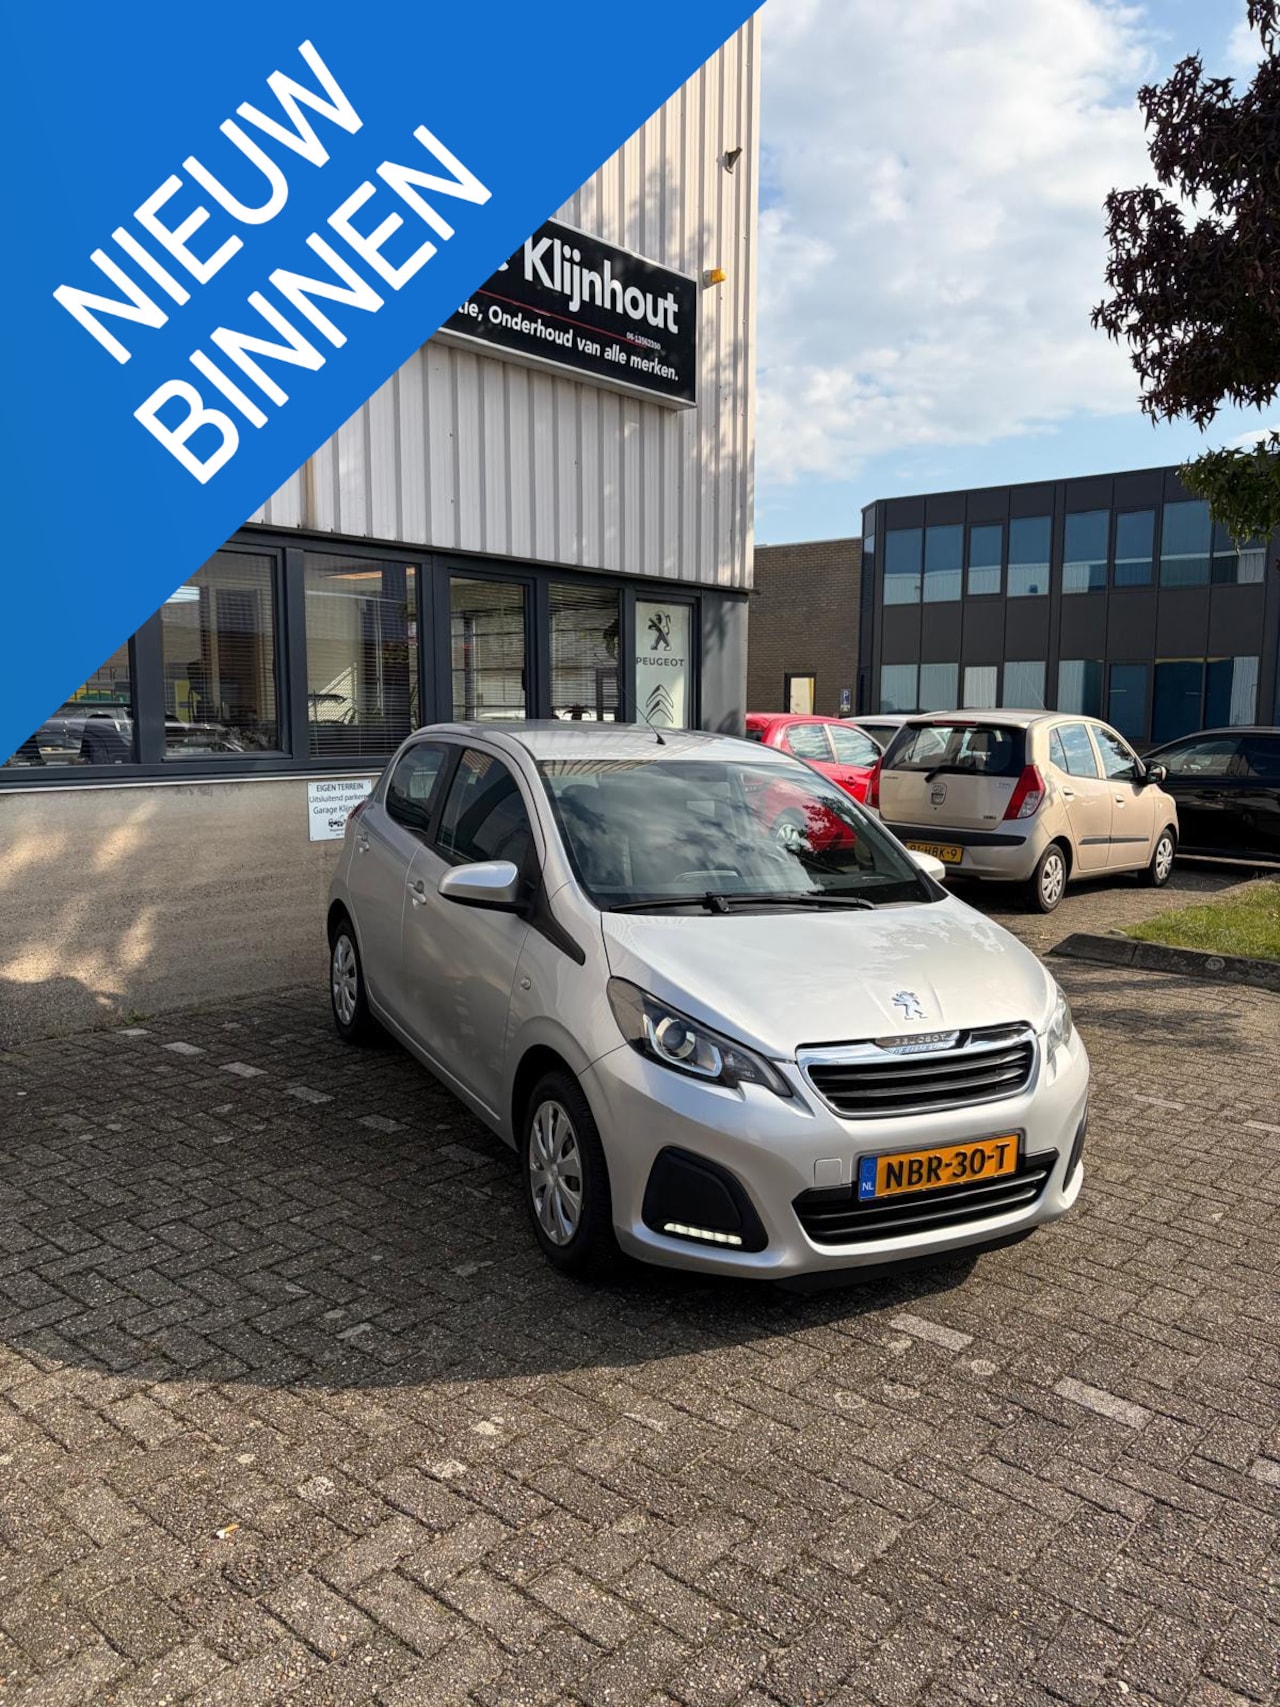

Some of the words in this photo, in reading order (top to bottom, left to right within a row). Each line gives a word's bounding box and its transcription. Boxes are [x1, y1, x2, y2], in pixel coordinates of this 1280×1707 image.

[524, 236, 679, 334] Klijnhout
[489, 306, 573, 347] Onderhoud
[577, 337, 600, 357] van
[604, 344, 627, 364] alle
[630, 355, 679, 381] merken.
[636, 657, 685, 667] PEUGEOT
[316, 784, 336, 792] EIGEN
[337, 783, 364, 791] TERREIN
[309, 795, 343, 803] Uitsluitend
[344, 794, 368, 802] parkere
[313, 806, 338, 815] Garage
[862, 1181, 874, 1191] NL
[885, 1143, 1010, 1190] NBR-30-T
